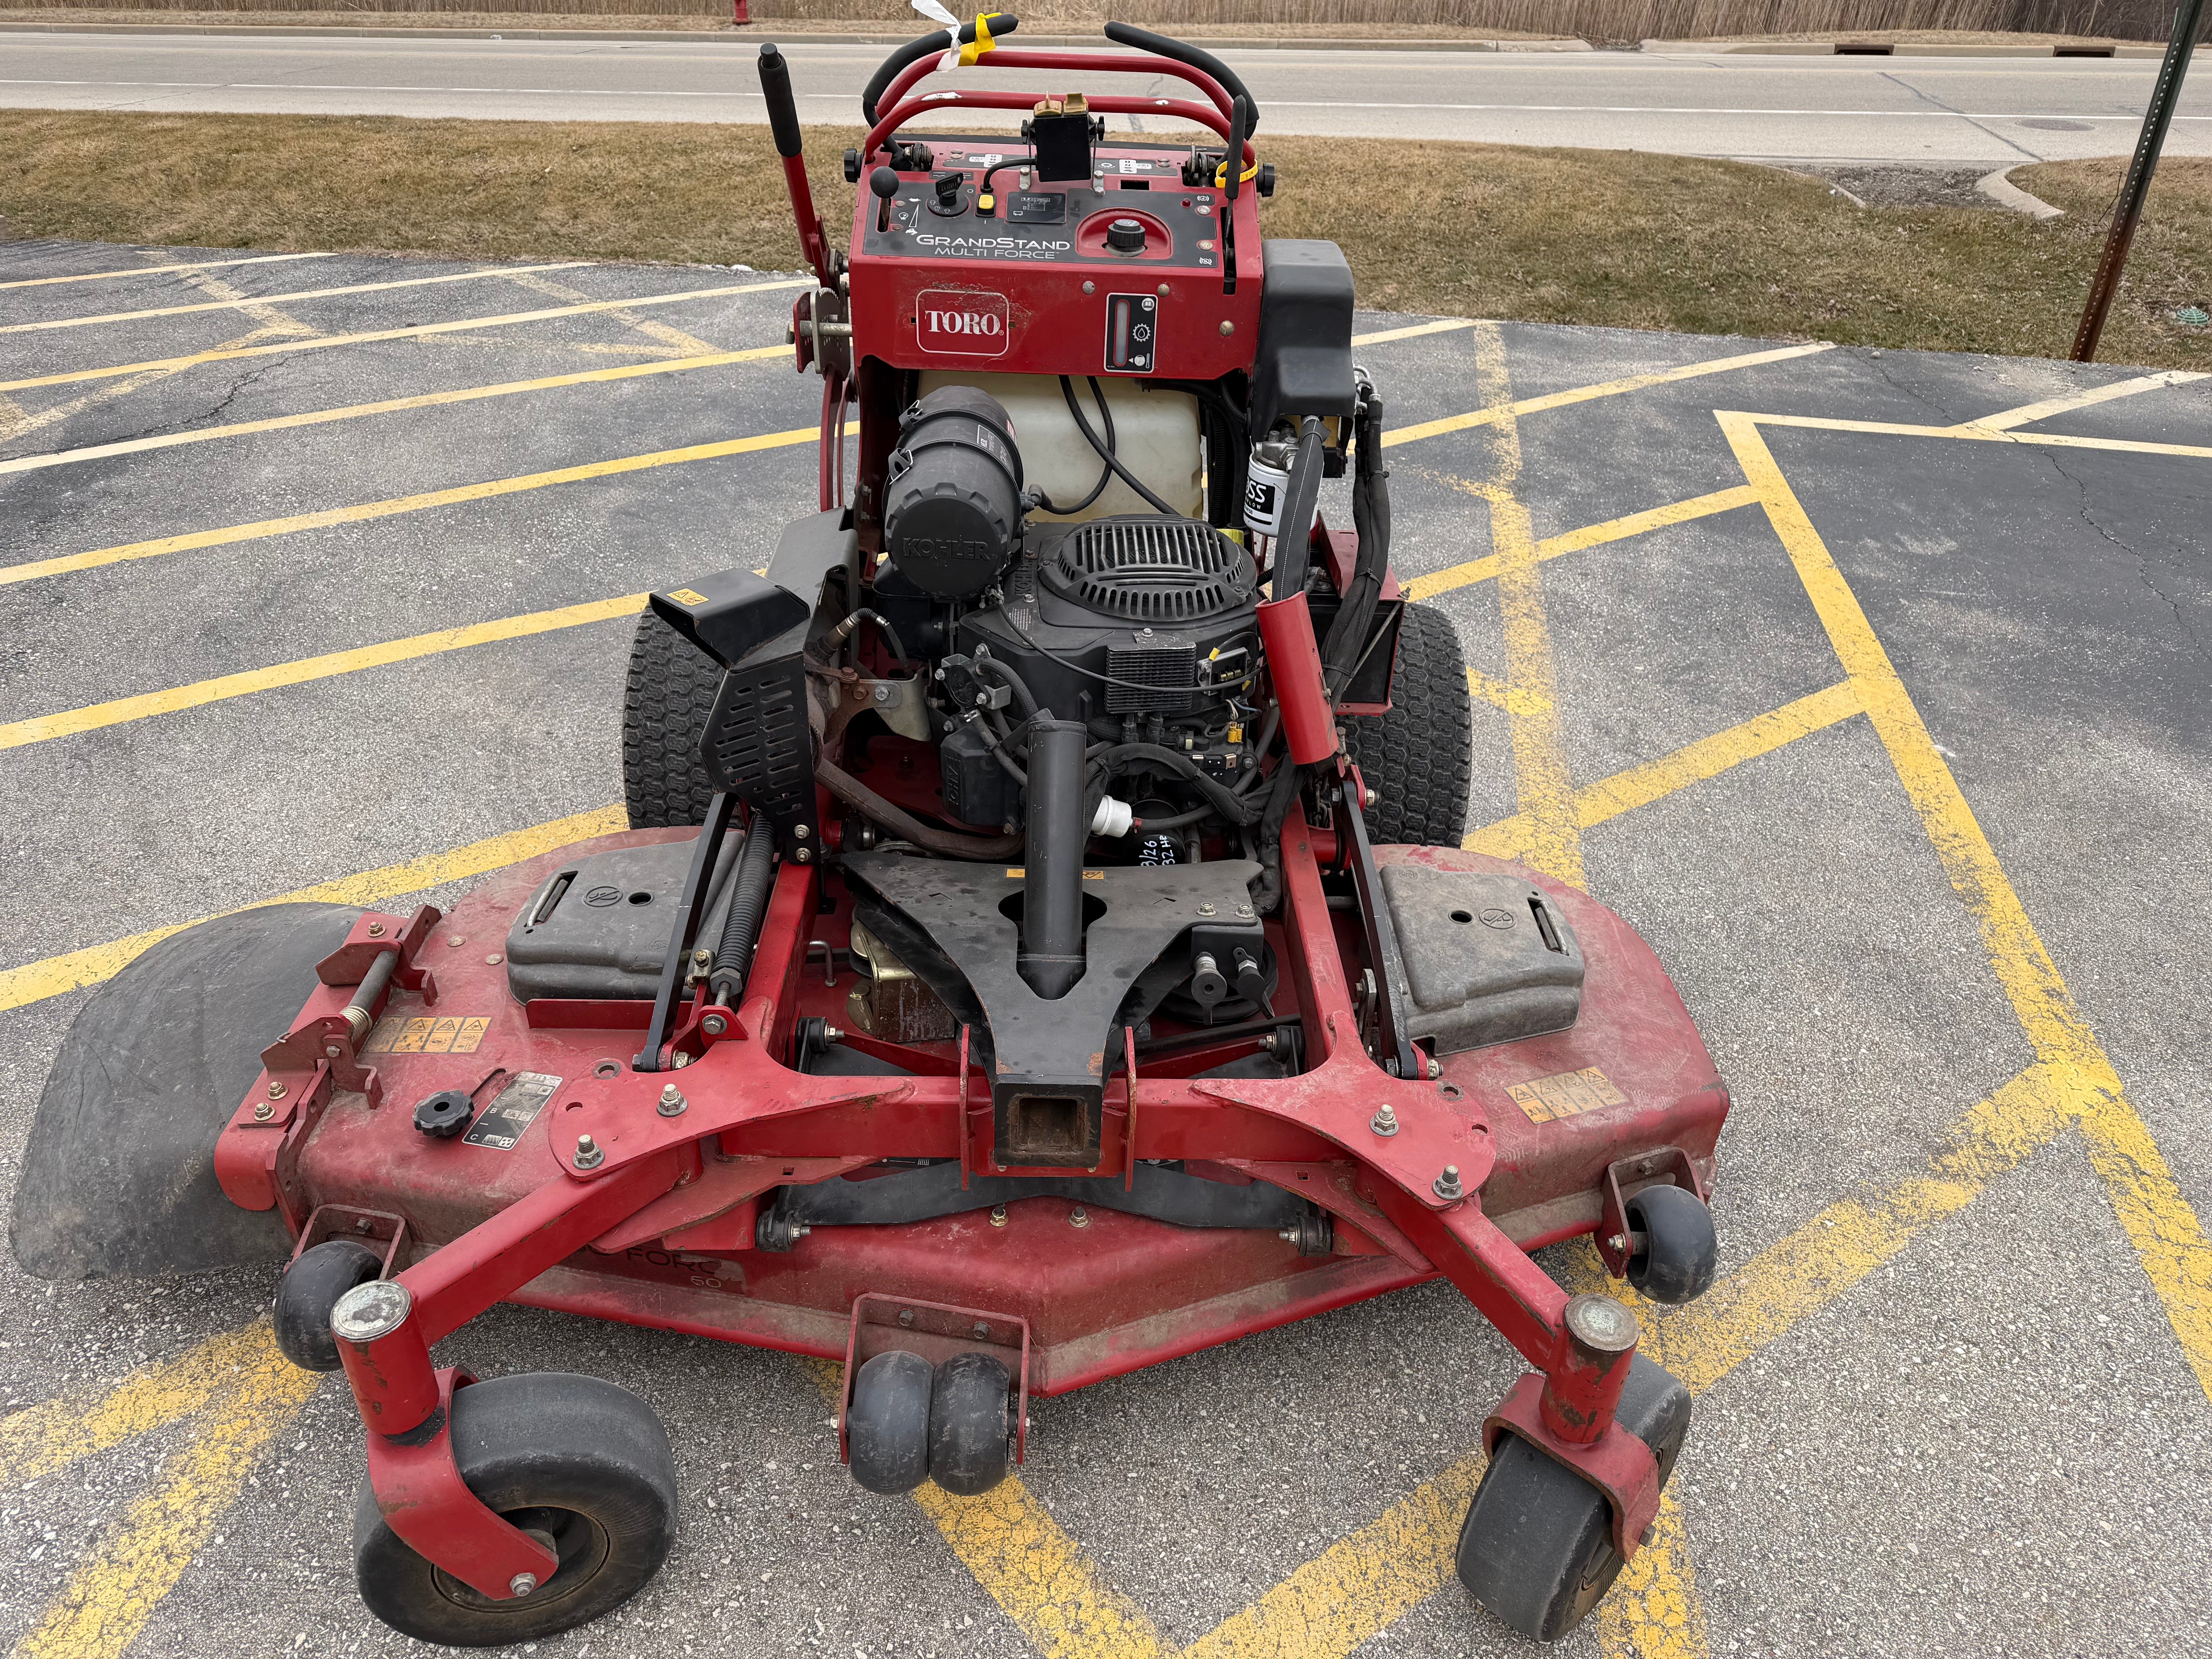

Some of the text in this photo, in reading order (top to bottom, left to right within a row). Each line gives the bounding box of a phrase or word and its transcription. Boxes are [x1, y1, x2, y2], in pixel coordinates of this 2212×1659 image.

[934, 247, 1055, 259] MULTI FORCE
[925, 310, 1001, 335] TORO
[903, 537, 990, 560] KOHLER
[626, 1247, 716, 1275] FORC
[690, 1276, 722, 1288] 60
